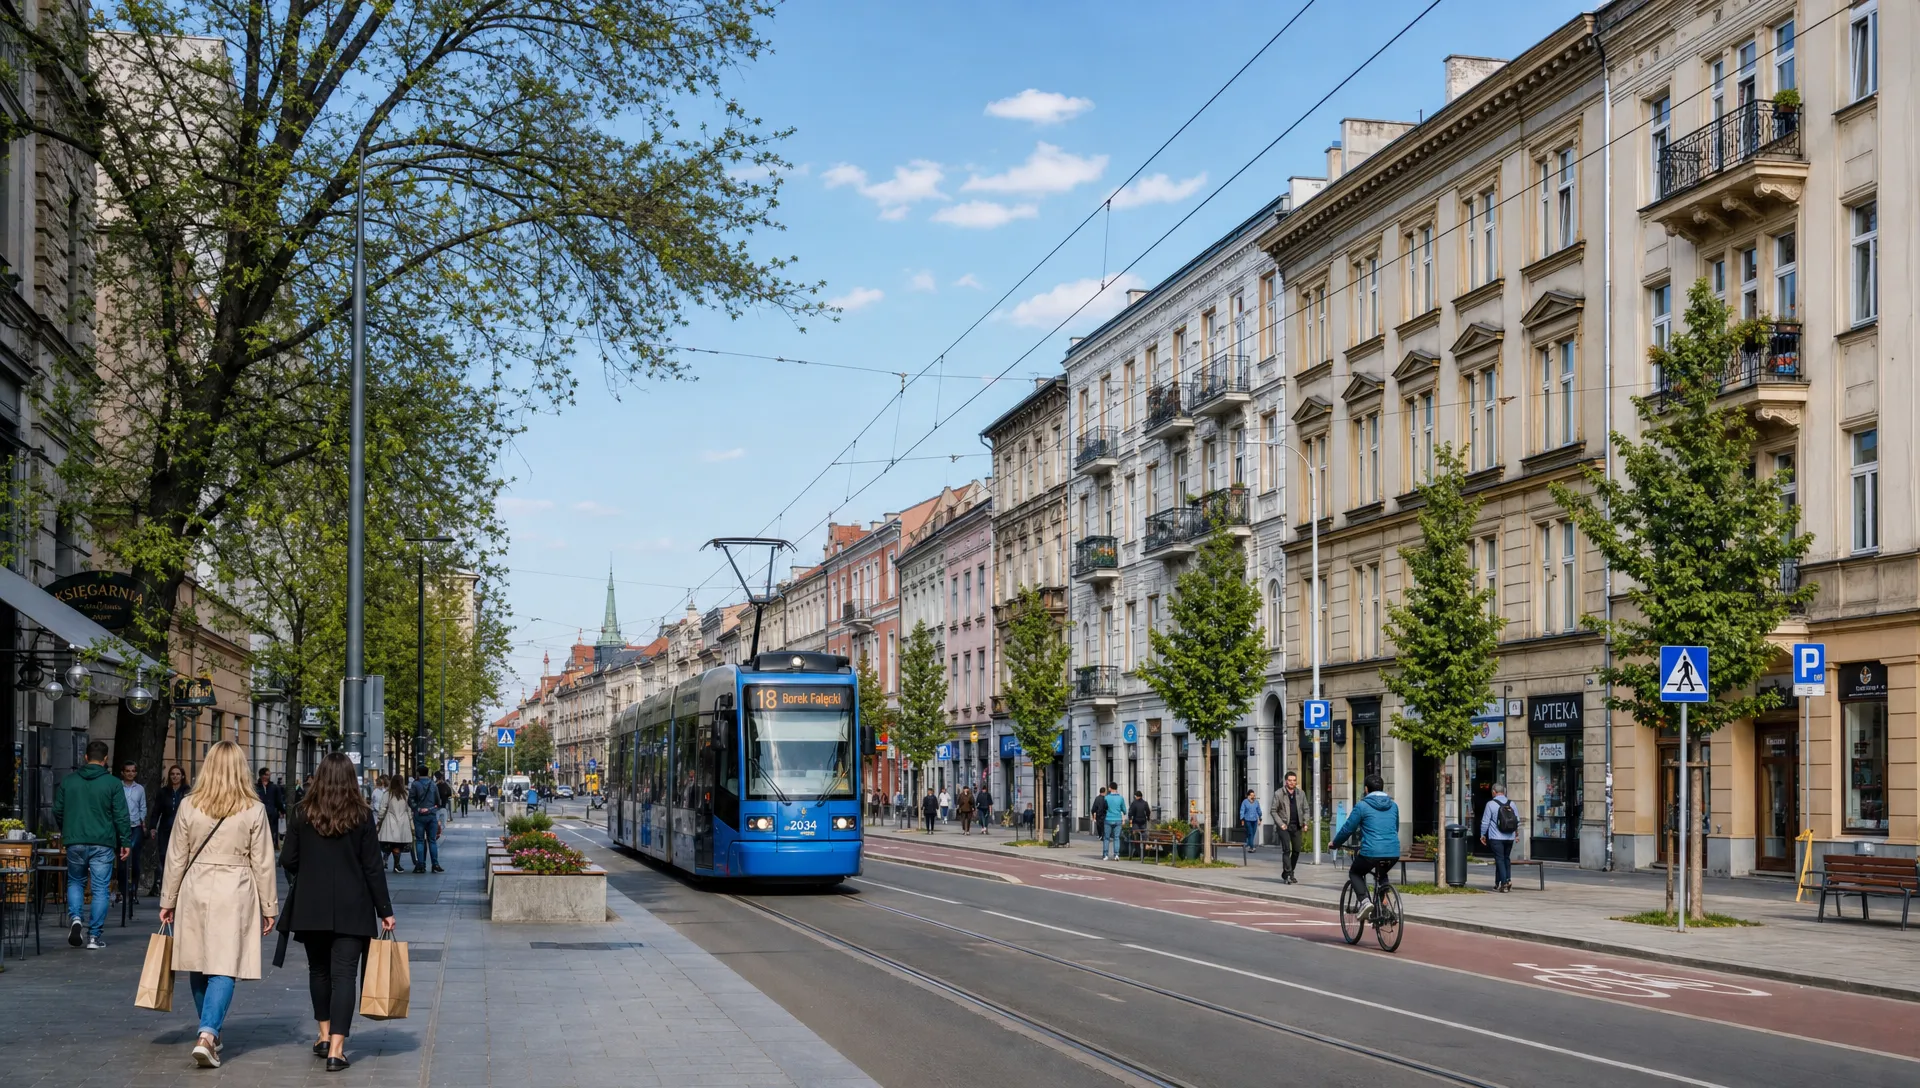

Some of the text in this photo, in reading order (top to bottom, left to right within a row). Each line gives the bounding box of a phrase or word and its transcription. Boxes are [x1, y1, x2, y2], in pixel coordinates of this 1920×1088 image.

[55, 584, 143, 605] KSIĘGARNIA
[1801, 648, 1820, 678] P
[756, 689, 778, 709] 18
[782, 692, 808, 704] Borek
[1310, 703, 1326, 725] P
[1533, 701, 1578, 721] APTEKA
[790, 820, 817, 831] 2034
